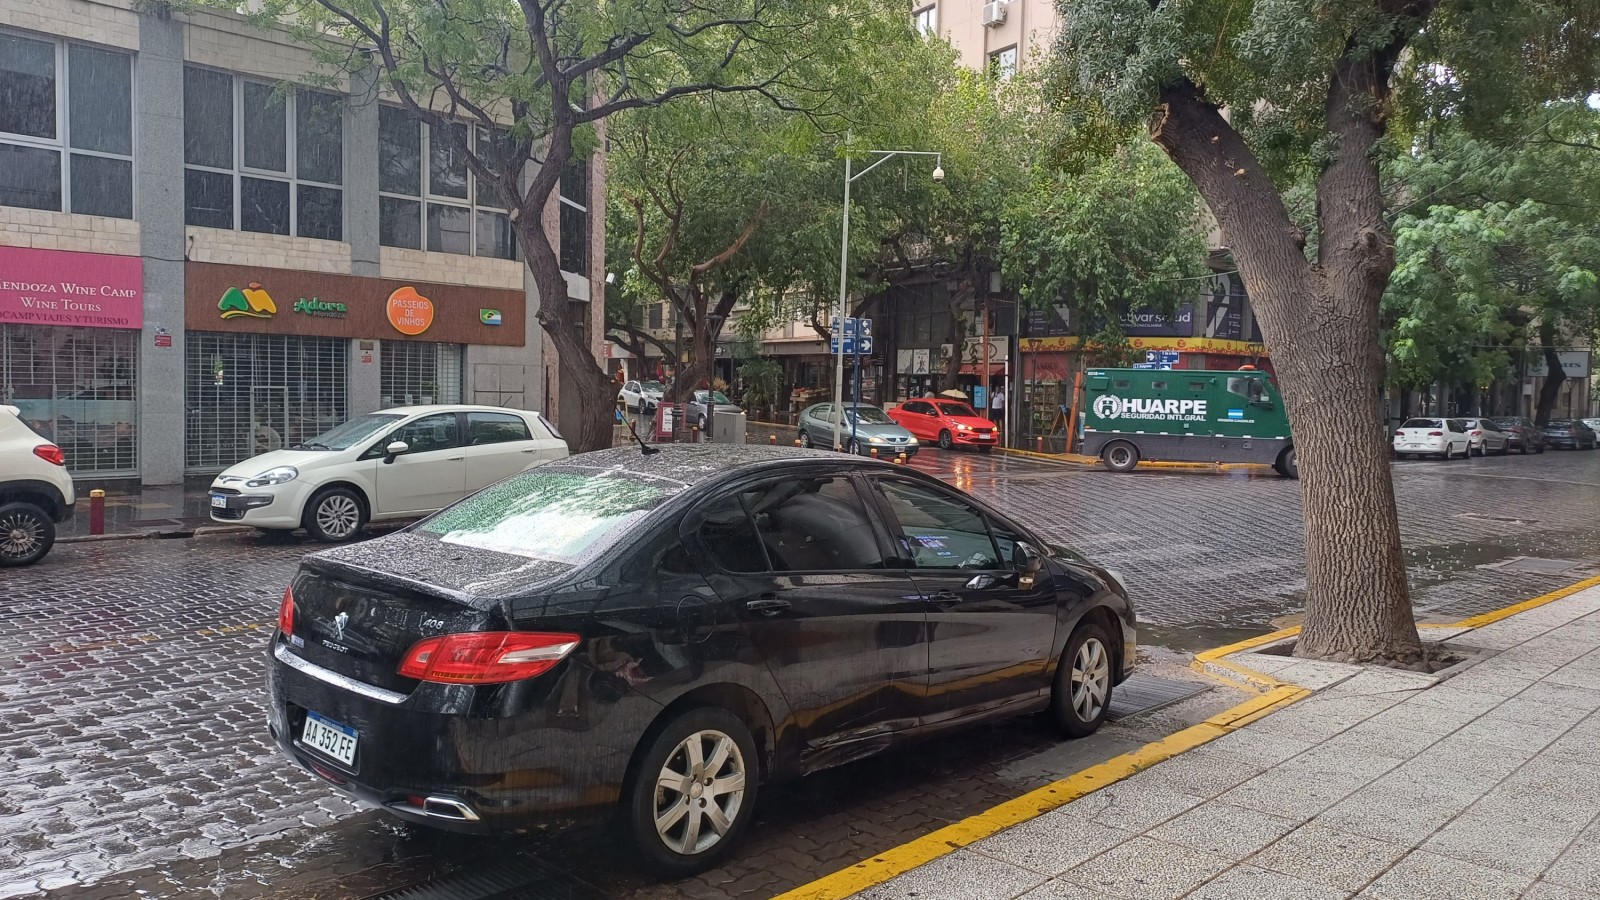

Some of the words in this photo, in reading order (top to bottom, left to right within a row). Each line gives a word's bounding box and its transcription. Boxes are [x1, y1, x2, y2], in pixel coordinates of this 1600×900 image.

[0, 281, 57, 293] ENDOZA
[60, 282, 97, 296] WINE
[100, 285, 137, 298] CAMP
[20, 296, 59, 310] WINE
[61, 298, 102, 312] TOURS
[294, 297, 347, 314] Adora
[392, 300, 429, 310] PASSEIOS
[35, 312, 72, 323] VIAJES
[82, 315, 129, 326] TURISMO
[405, 309, 415, 317] DE
[397, 317, 425, 326] VINHOS
[1122, 398, 1207, 415] HUARPE
[1120, 412, 1166, 420] SEGURIDAD
[423, 619, 444, 630] 408
[305, 720, 318, 744] AA
[319, 726, 338, 753] 352
[339, 736, 353, 761] FE
